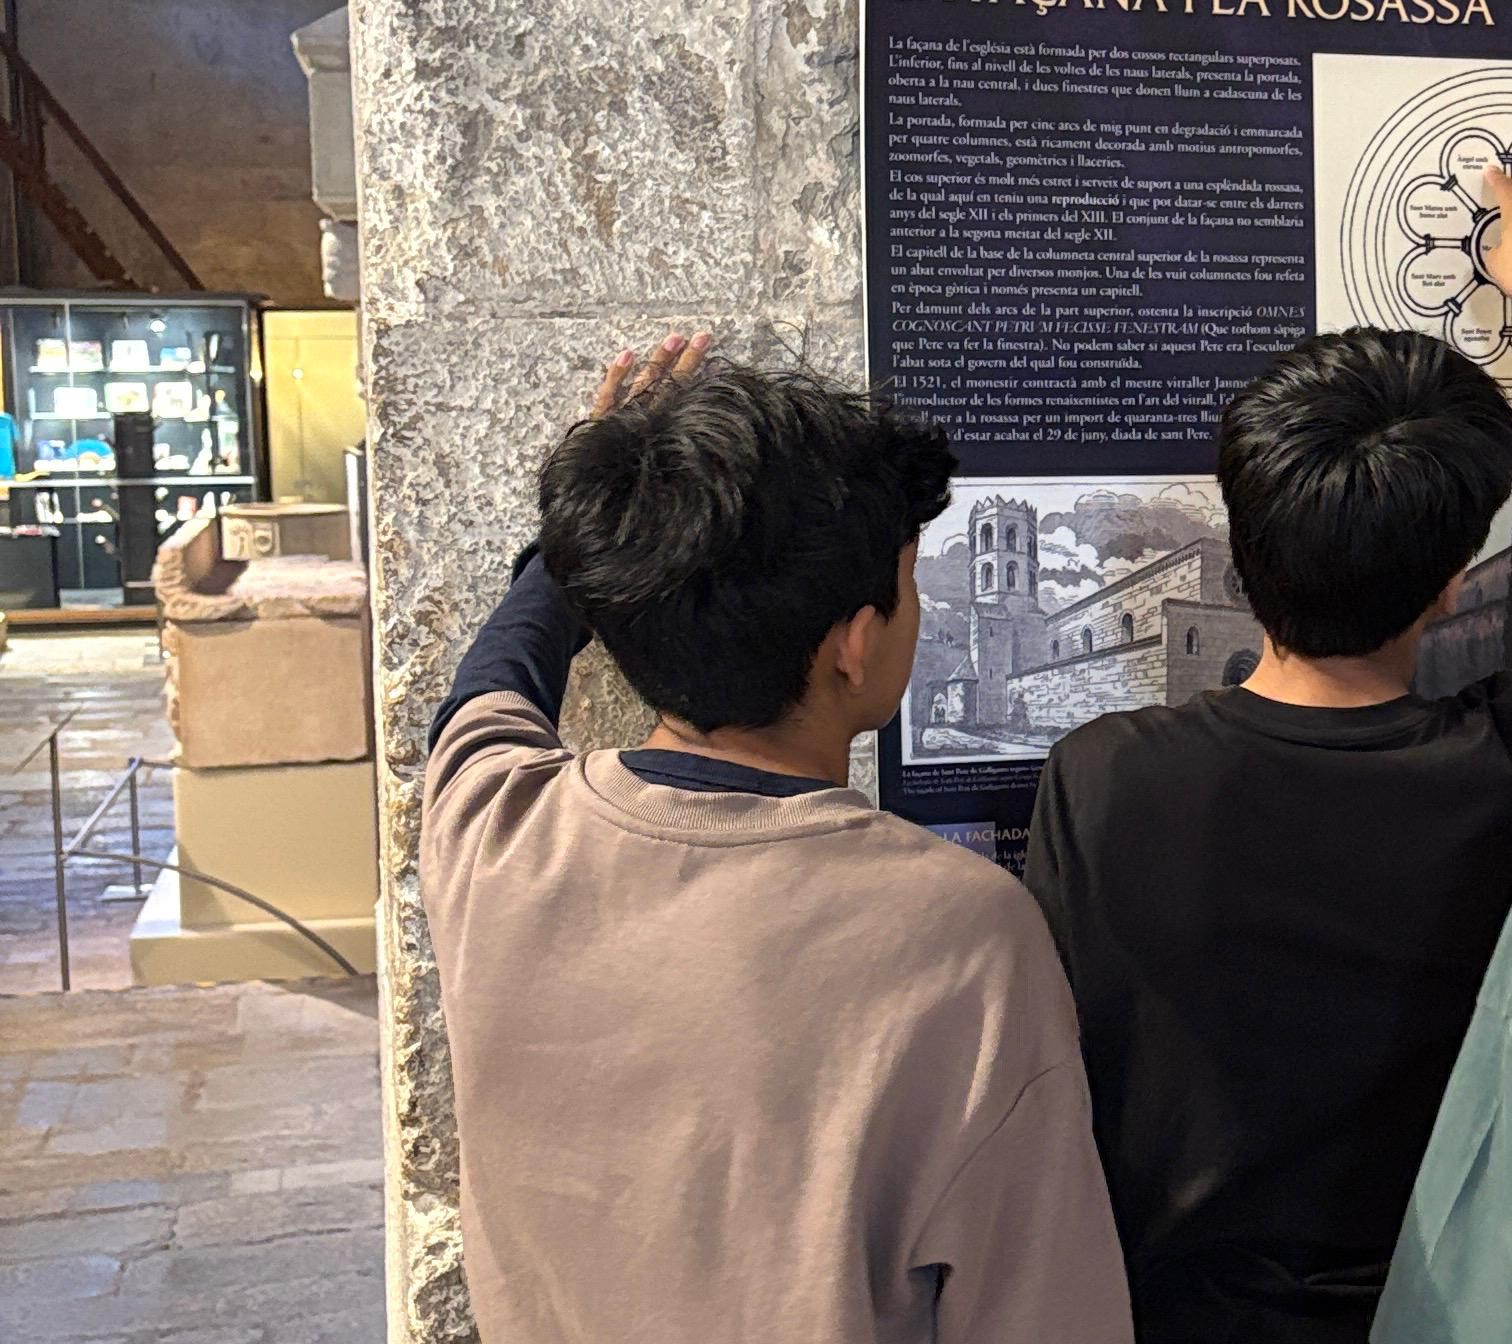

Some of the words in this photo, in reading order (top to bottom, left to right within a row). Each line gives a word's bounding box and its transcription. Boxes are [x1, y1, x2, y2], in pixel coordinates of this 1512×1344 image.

[889, 36, 903, 49] La
[906, 37, 942, 55] façana
[945, 39, 960, 52] de
[1013, 41, 1035, 55] està
[1038, 42, 1085, 57] formada
[1088, 48, 1106, 61] per
[1109, 45, 1129, 58] dos
[1168, 47, 1234, 66] rectangulars
[947, 58, 968, 71] fins
[971, 58, 981, 71] al
[985, 59, 1015, 73] nivell
[1018, 60, 1032, 73] de
[1036, 61, 1051, 74] les
[1053, 61, 1086, 75] voltes
[1088, 63, 1102, 76] de
[1105, 63, 1120, 76] les
[1123, 68, 1148, 77] naus
[1196, 67, 1241, 84] presenta
[1244, 68, 1253, 81] la
[888, 95, 915, 105] naus
[889, 112, 903, 125] La
[958, 115, 1006, 129] formada
[1009, 120, 1028, 133] per
[1030, 117, 1054, 130] cinc
[1058, 121, 1080, 131] arcs
[1082, 119, 1096, 132] de
[1100, 119, 1122, 136] mig
[1125, 120, 1151, 137] punt
[1171, 121, 1230, 139] degradació
[888, 134, 908, 147] per
[911, 131, 949, 148] quatre
[1014, 134, 1037, 147] està
[1041, 135, 1090, 149] ricament
[1094, 137, 1145, 151] decorada
[1148, 138, 1174, 152] amb
[1177, 139, 1215, 153] motius
[888, 188, 903, 201] de
[906, 189, 916, 201] la
[919, 189, 944, 205] qual
[948, 189, 973, 206] aquí
[994, 190, 1023, 204] teniu
[1026, 195, 1048, 204] una
[1051, 192, 1119, 209] reproducció
[1128, 197, 1150, 210] que
[1152, 194, 1171, 210] pot
[1174, 194, 1216, 208] datar-se
[1219, 195, 1248, 208] entre
[1250, 196, 1264, 209] els
[1266, 196, 1304, 210] darrers
[890, 224, 936, 238] anterior
[949, 226, 959, 238] la
[962, 229, 1001, 242] segona
[1004, 226, 1040, 240] meitat
[1043, 227, 1060, 240] del
[1064, 227, 1091, 244] segle
[908, 280, 942, 297] època
[945, 281, 980, 297] gòtica
[991, 282, 1028, 294] només
[1031, 282, 1078, 299] presenta
[1081, 286, 1096, 295] un
[892, 341, 914, 354] que
[918, 338, 943, 350] Pere
[947, 341, 959, 350] va
[963, 338, 979, 350] fer
[982, 338, 993, 350] la
[1052, 338, 1070, 351] No
[1074, 338, 1112, 354] podem
[1116, 338, 1145, 351] saber
[1148, 339, 1157, 351] si
[1160, 339, 1195, 355] aquest
[1200, 339, 1223, 351] Pere
[893, 356, 924, 368] l'abat
[928, 356, 951, 368] sota
[954, 356, 964, 368] el
[967, 359, 1006, 372] govern
[1009, 356, 1026, 368] del
[1029, 356, 1054, 372] qual
[1058, 356, 1077, 369] fou
[950, 376, 960, 388] el
[966, 376, 1018, 388] monestir
[1022, 376, 1076, 388] contractà
[1080, 376, 1106, 389] amb
[1110, 376, 1120, 389] el
[1125, 376, 1162, 389] mestre
[953, 428, 991, 441] d'estar
[994, 428, 1029, 441] acabat
[1032, 428, 1042, 441] el
[1046, 428, 1061, 441] 29
[1064, 428, 1078, 441] de
[1110, 428, 1141, 440] diada
[1144, 428, 1158, 440] de
[1160, 428, 1182, 440] sant
